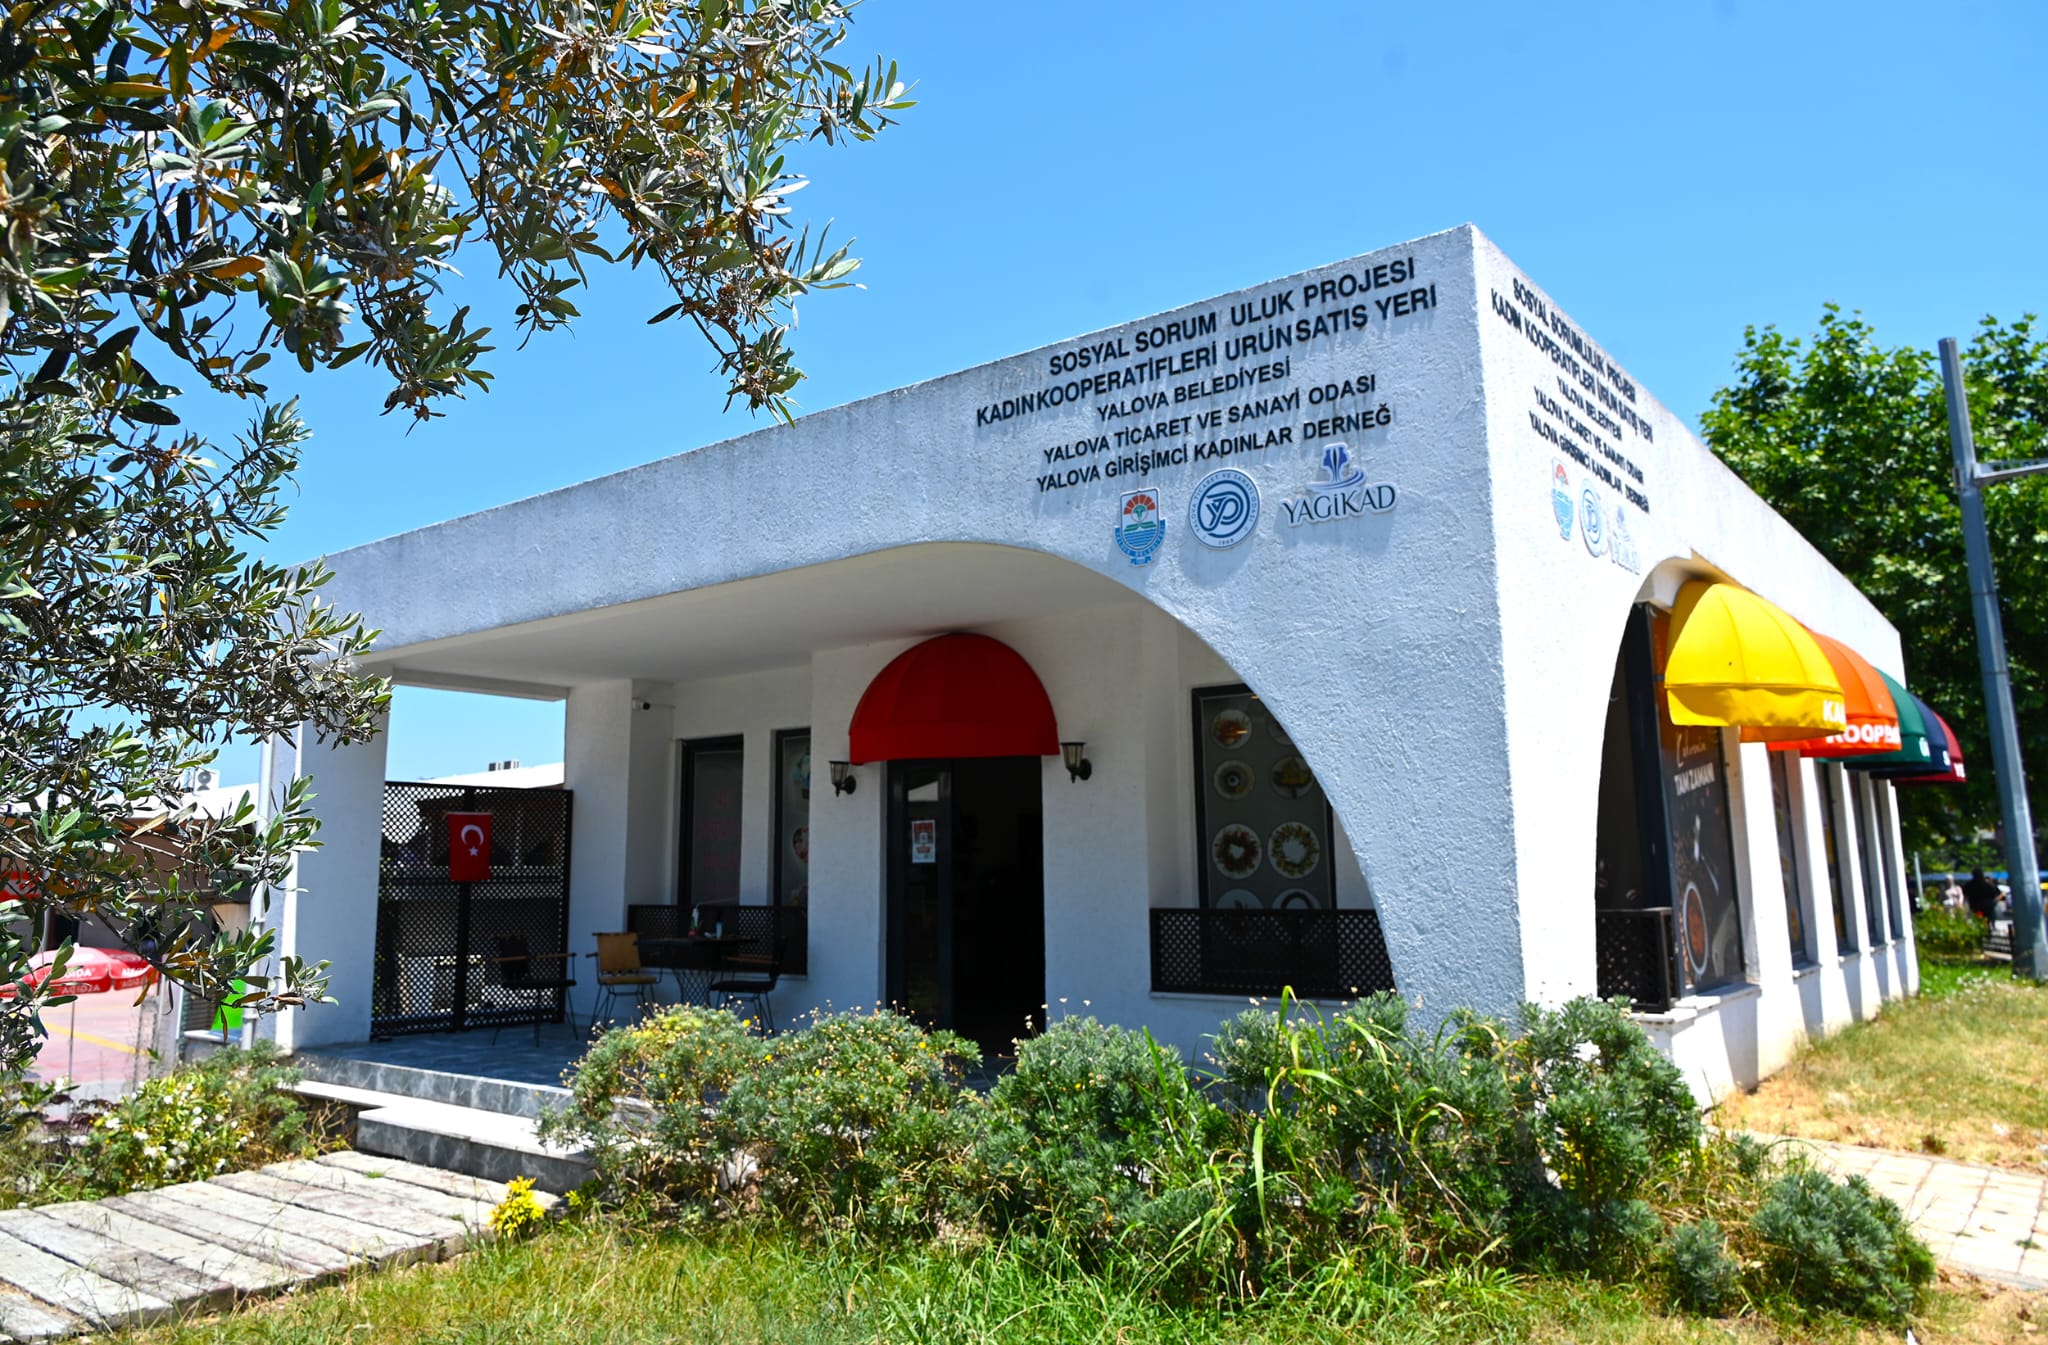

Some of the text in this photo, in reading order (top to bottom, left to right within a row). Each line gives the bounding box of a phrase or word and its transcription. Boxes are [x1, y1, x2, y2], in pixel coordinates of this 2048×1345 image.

[1513, 277, 1549, 327] SOSYAL
[1050, 338, 1130, 376] SOSYAL
[1135, 312, 1217, 352] SORUM
[1231, 290, 1294, 327] ULUK
[1097, 355, 1290, 422] YALOVA BELEDİYESİ
[1533, 385, 1564, 424] YALOVA
[1556, 375, 1585, 412] YALOVA
[1036, 402, 1391, 493] YALOVA GİRİŞİMCİ KADINLAR DERNEĞ
[1044, 374, 1376, 464] YALOVA TİCARET VE SANAYİ ODASI
[1529, 410, 1560, 448] YALOVA
